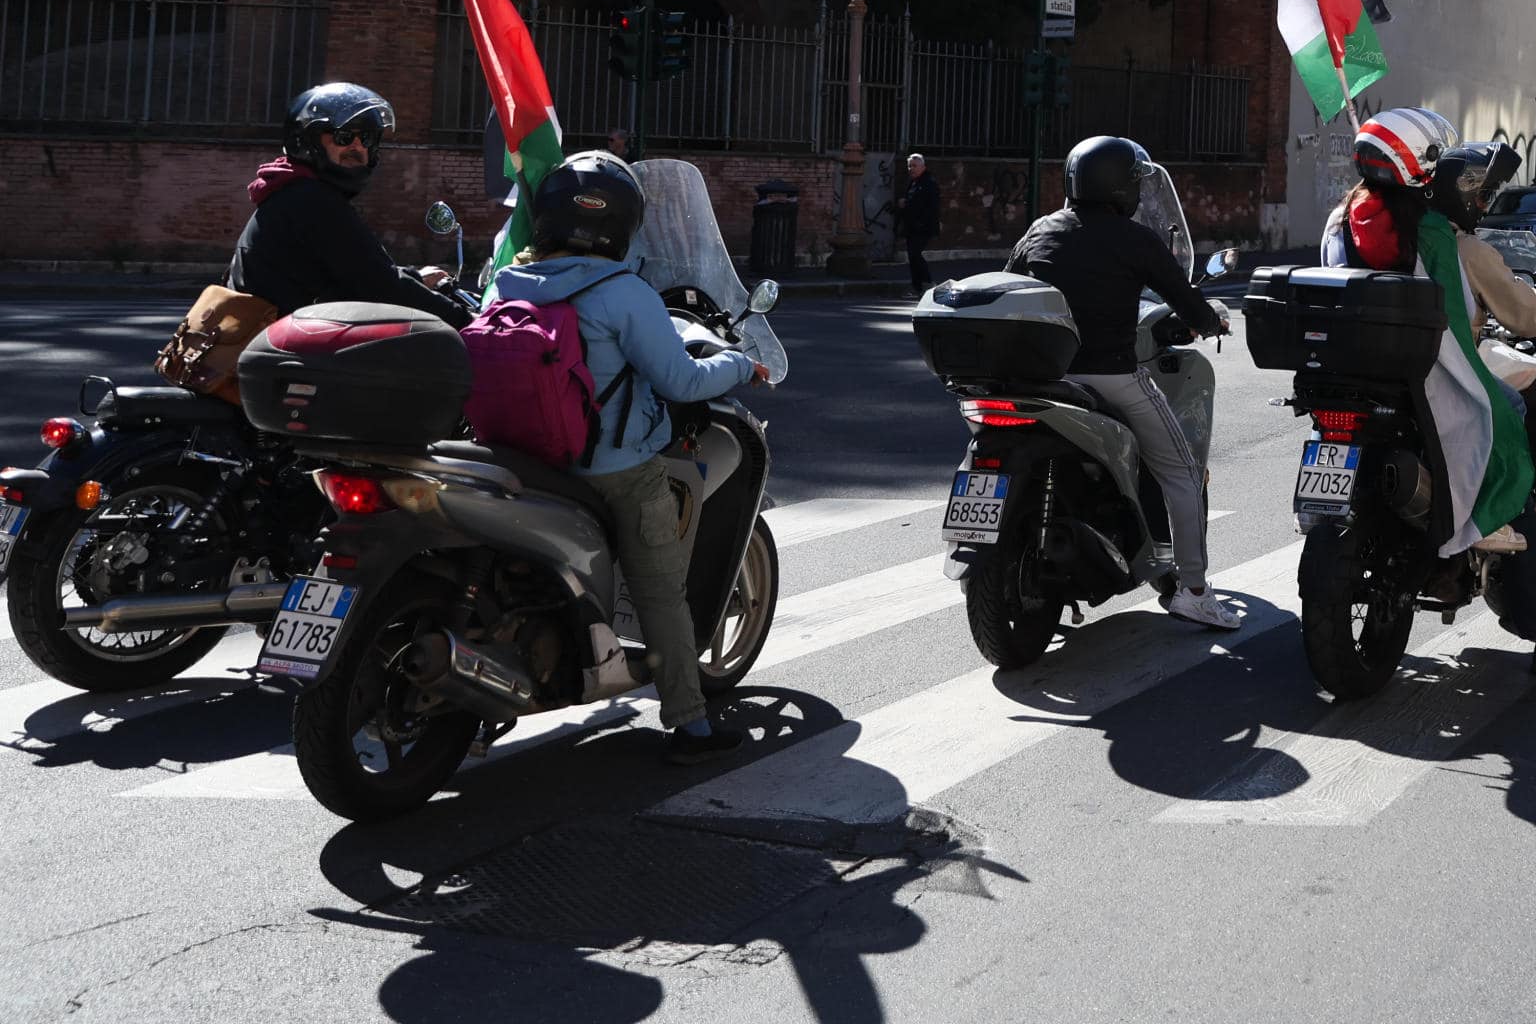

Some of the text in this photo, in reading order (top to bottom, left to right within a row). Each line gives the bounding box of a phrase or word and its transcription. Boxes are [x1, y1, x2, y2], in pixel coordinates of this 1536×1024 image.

[1317, 445, 1338, 466] ER
[966, 475, 988, 496] FJ
[1300, 471, 1352, 496] 77032
[949, 501, 1002, 524] 68553
[298, 582, 331, 612] EJ
[271, 618, 337, 654] 61783
